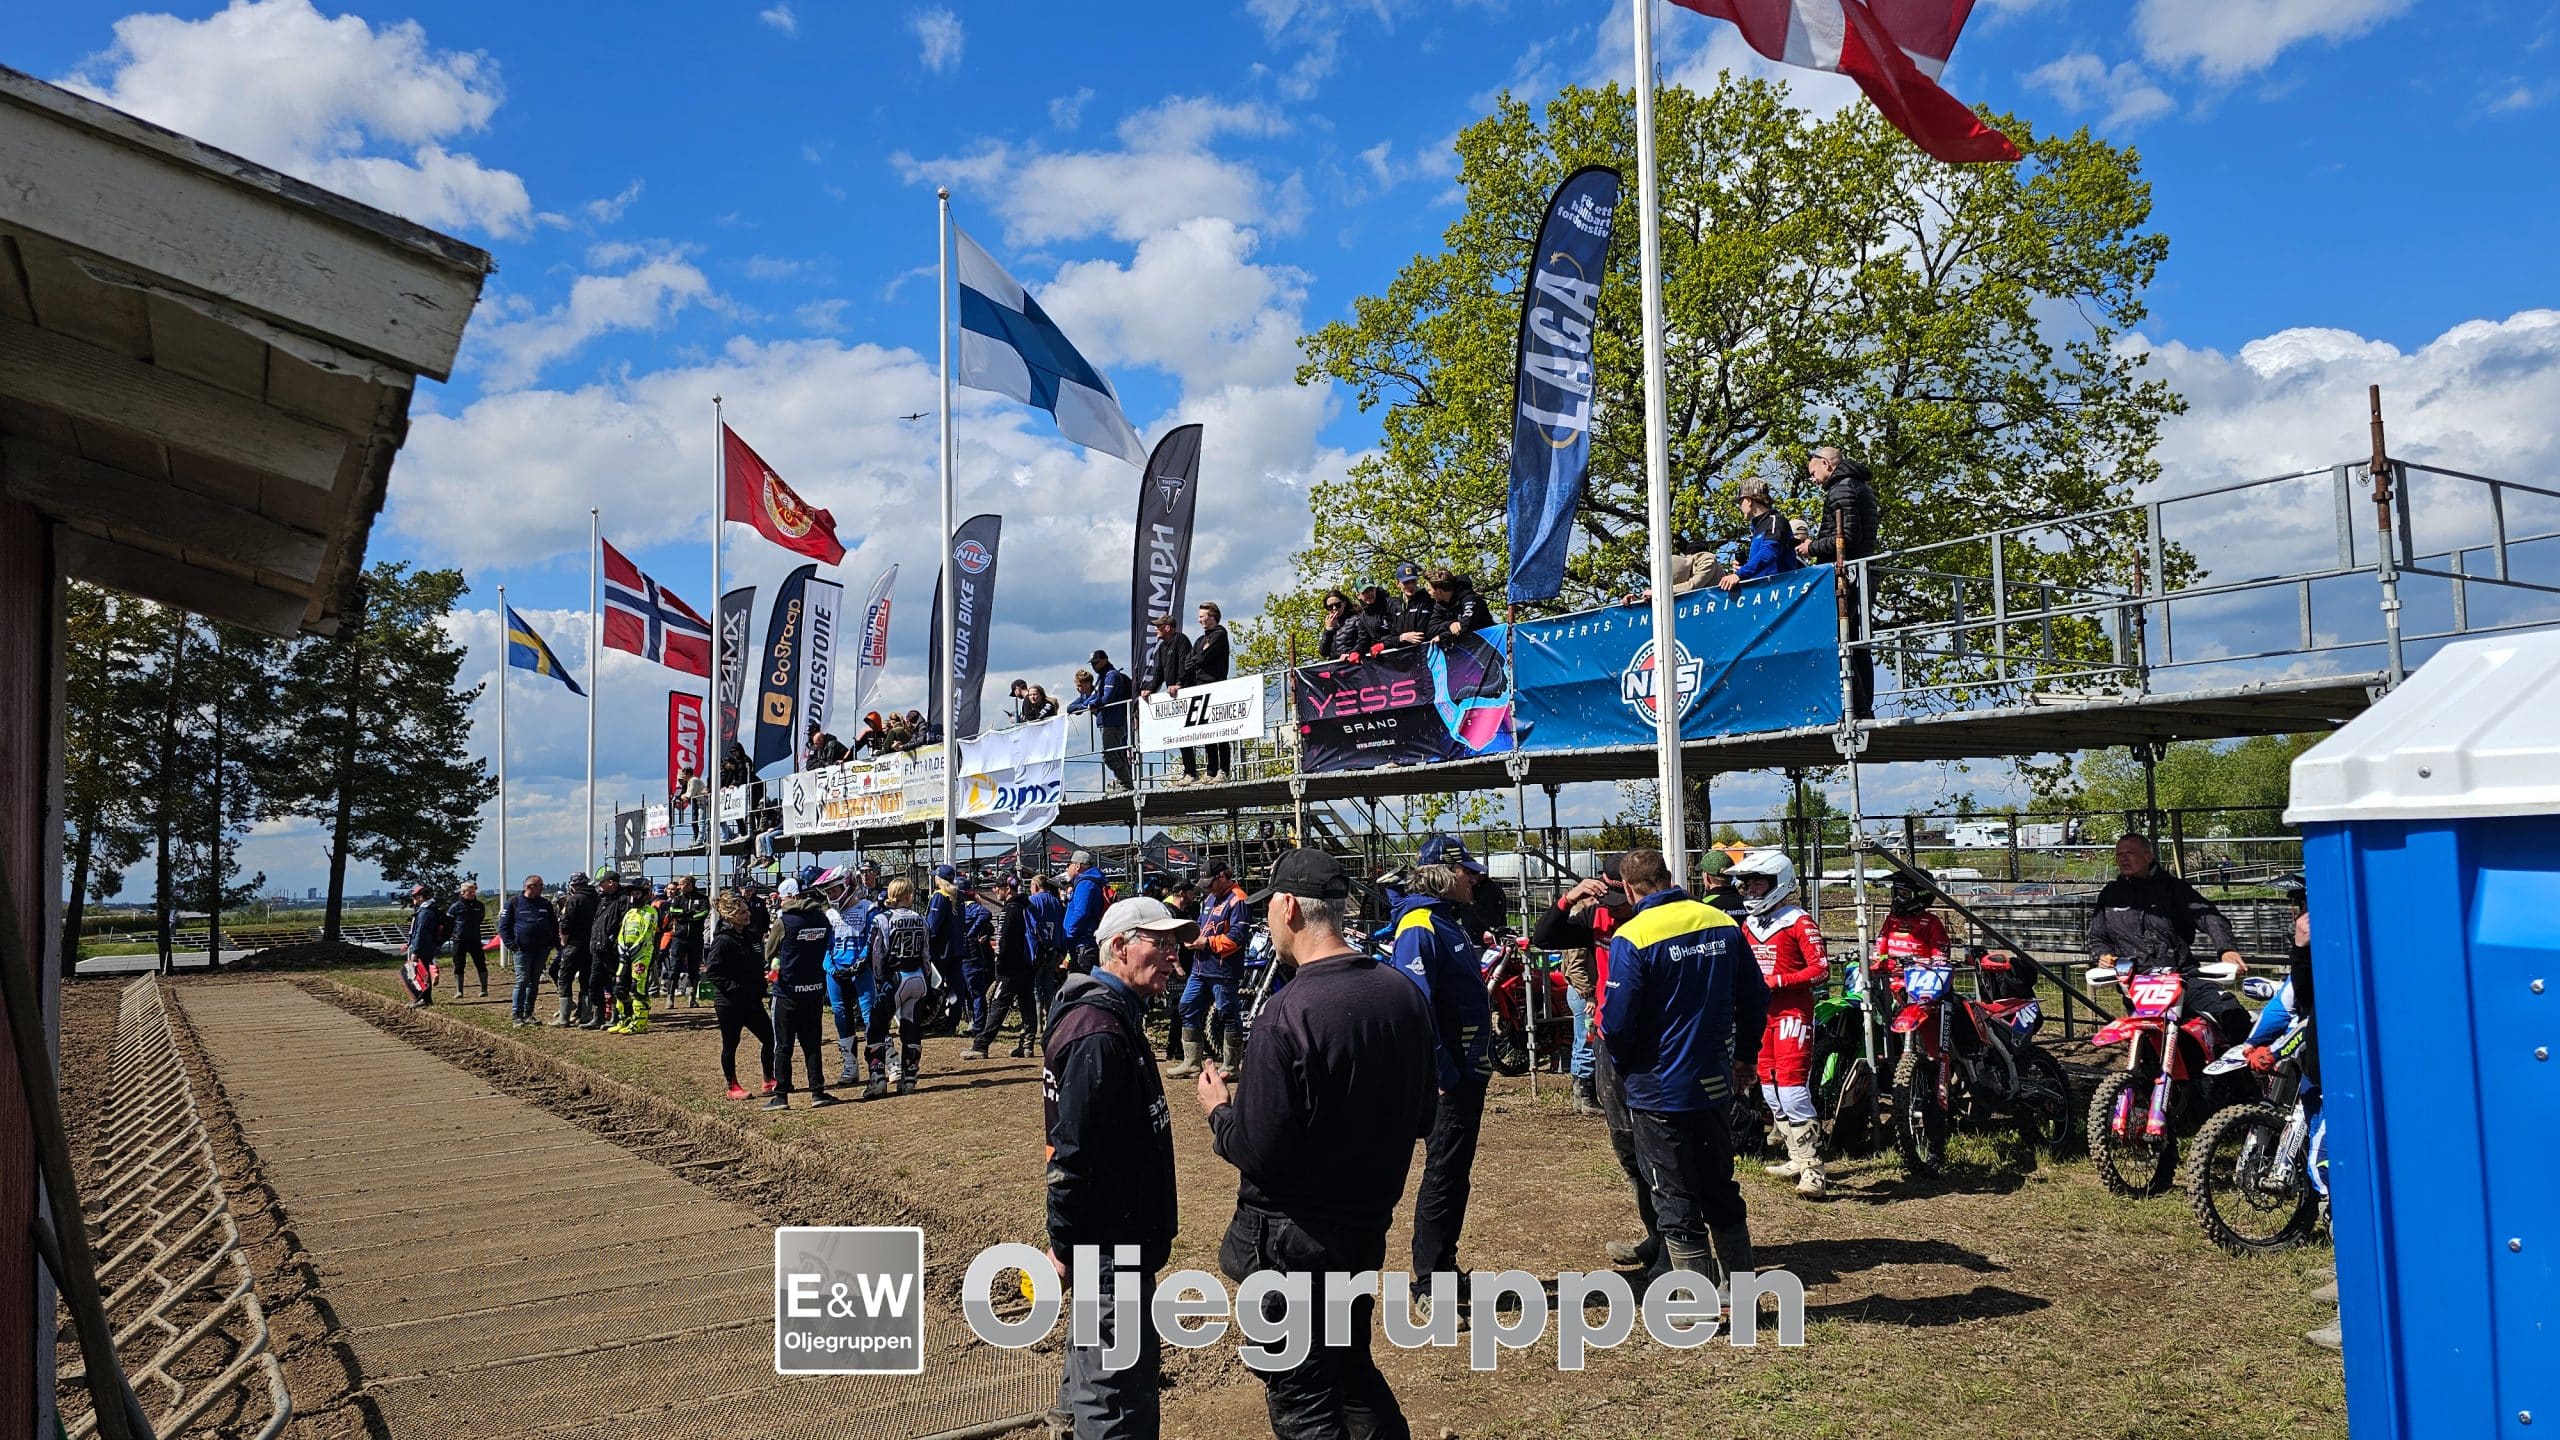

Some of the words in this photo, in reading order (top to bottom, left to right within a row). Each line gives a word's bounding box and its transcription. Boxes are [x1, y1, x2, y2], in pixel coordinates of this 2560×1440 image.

[1557, 206, 1609, 238] fordonsliv
[1571, 200, 1612, 228] hållbart
[1595, 206, 1612, 217] ett
[1522, 269, 1600, 432] LAGA
[955, 549, 990, 566] NILS
[958, 579, 975, 626] BIKE
[1529, 620, 1612, 645] EXPERTS
[1628, 612, 1649, 628] IN
[1678, 582, 1811, 620] UBRICANTS
[861, 605, 879, 668] Thermo
[871, 599, 891, 667] delivery
[720, 611, 741, 704] 24MX
[953, 630, 972, 680] YOUR
[1184, 693, 1212, 728] EL
[1211, 702, 1237, 722] SERVICE
[1237, 702, 1247, 718] AB
[1307, 679, 1417, 718] YESS
[1343, 718, 1398, 734] BRAND
[890, 918, 924, 930] HOVIND
[1680, 939, 1727, 958] Husqvarna
[2132, 983, 2177, 1005] 705
